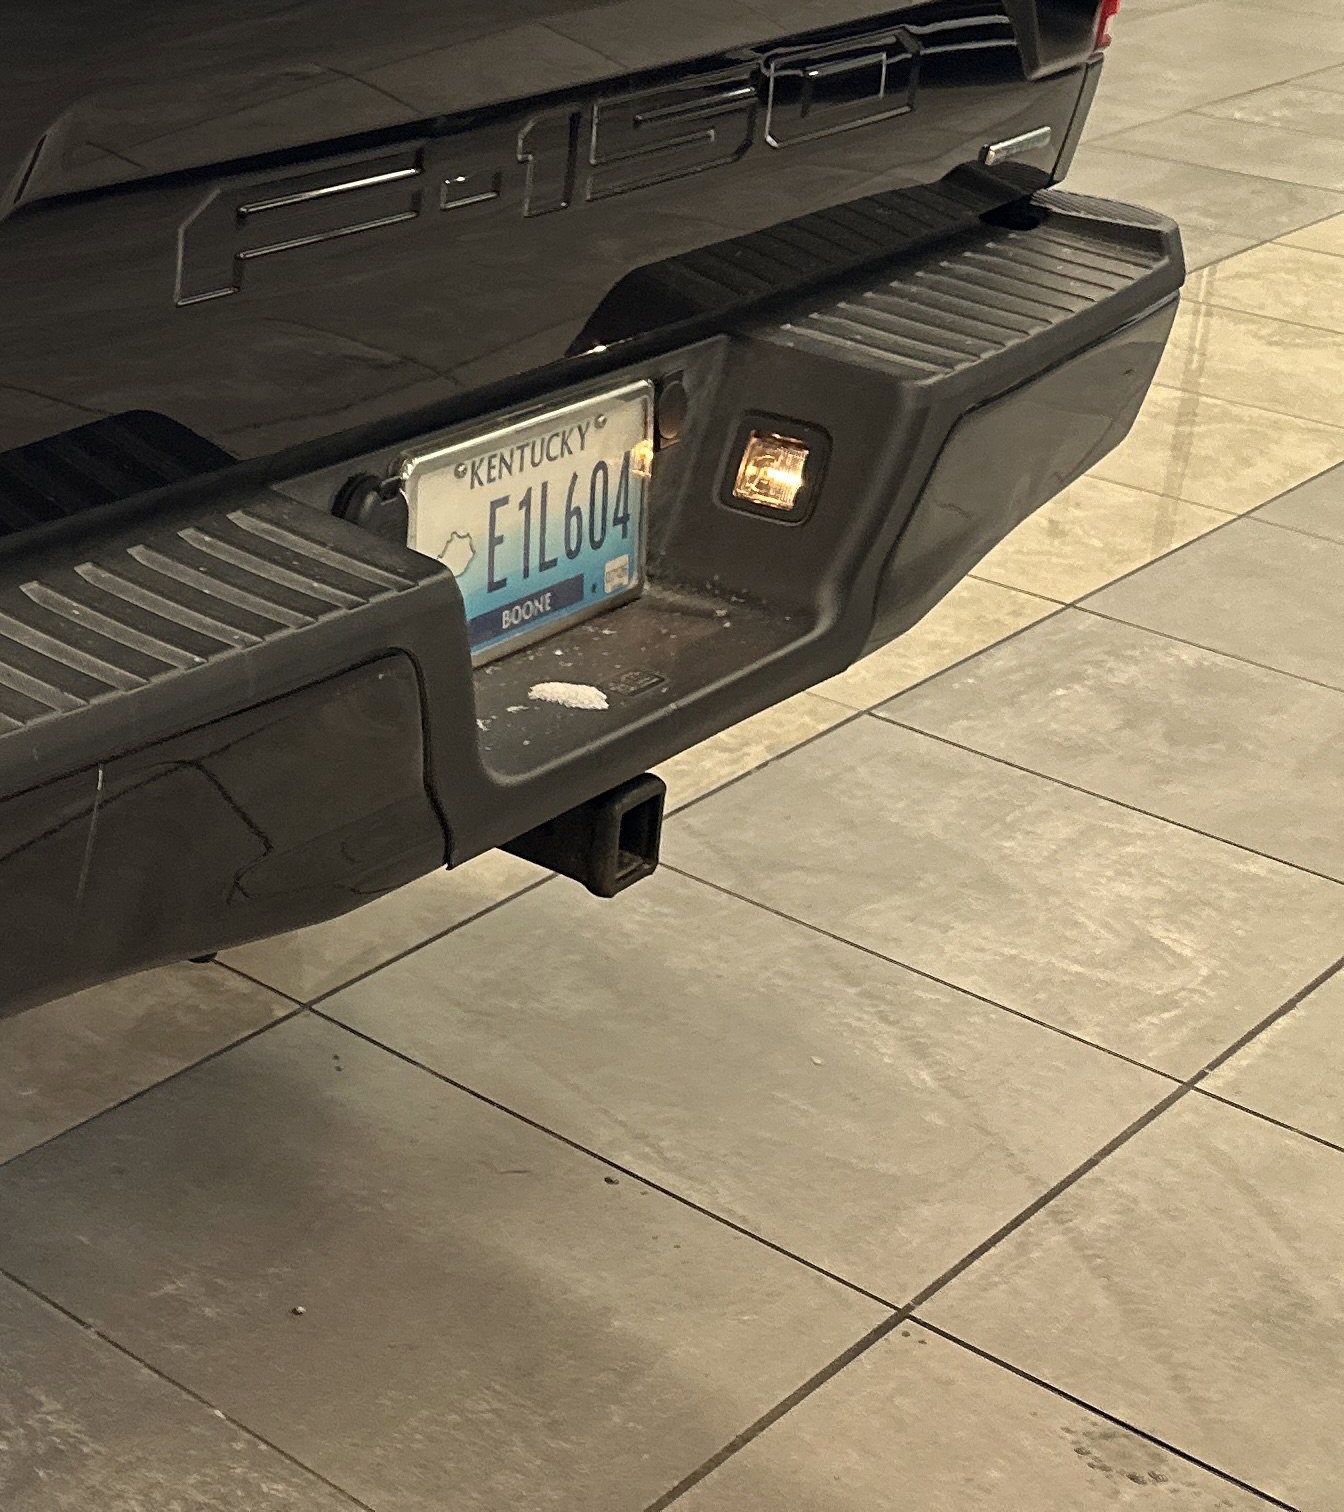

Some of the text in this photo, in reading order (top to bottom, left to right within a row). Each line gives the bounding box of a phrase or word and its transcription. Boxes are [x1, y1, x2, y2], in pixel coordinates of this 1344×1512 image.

[173, 25, 922, 307] F-150
[469, 420, 591, 490] KENTUCKY
[487, 449, 631, 594] E1L604
[501, 591, 553, 630] BOONE
